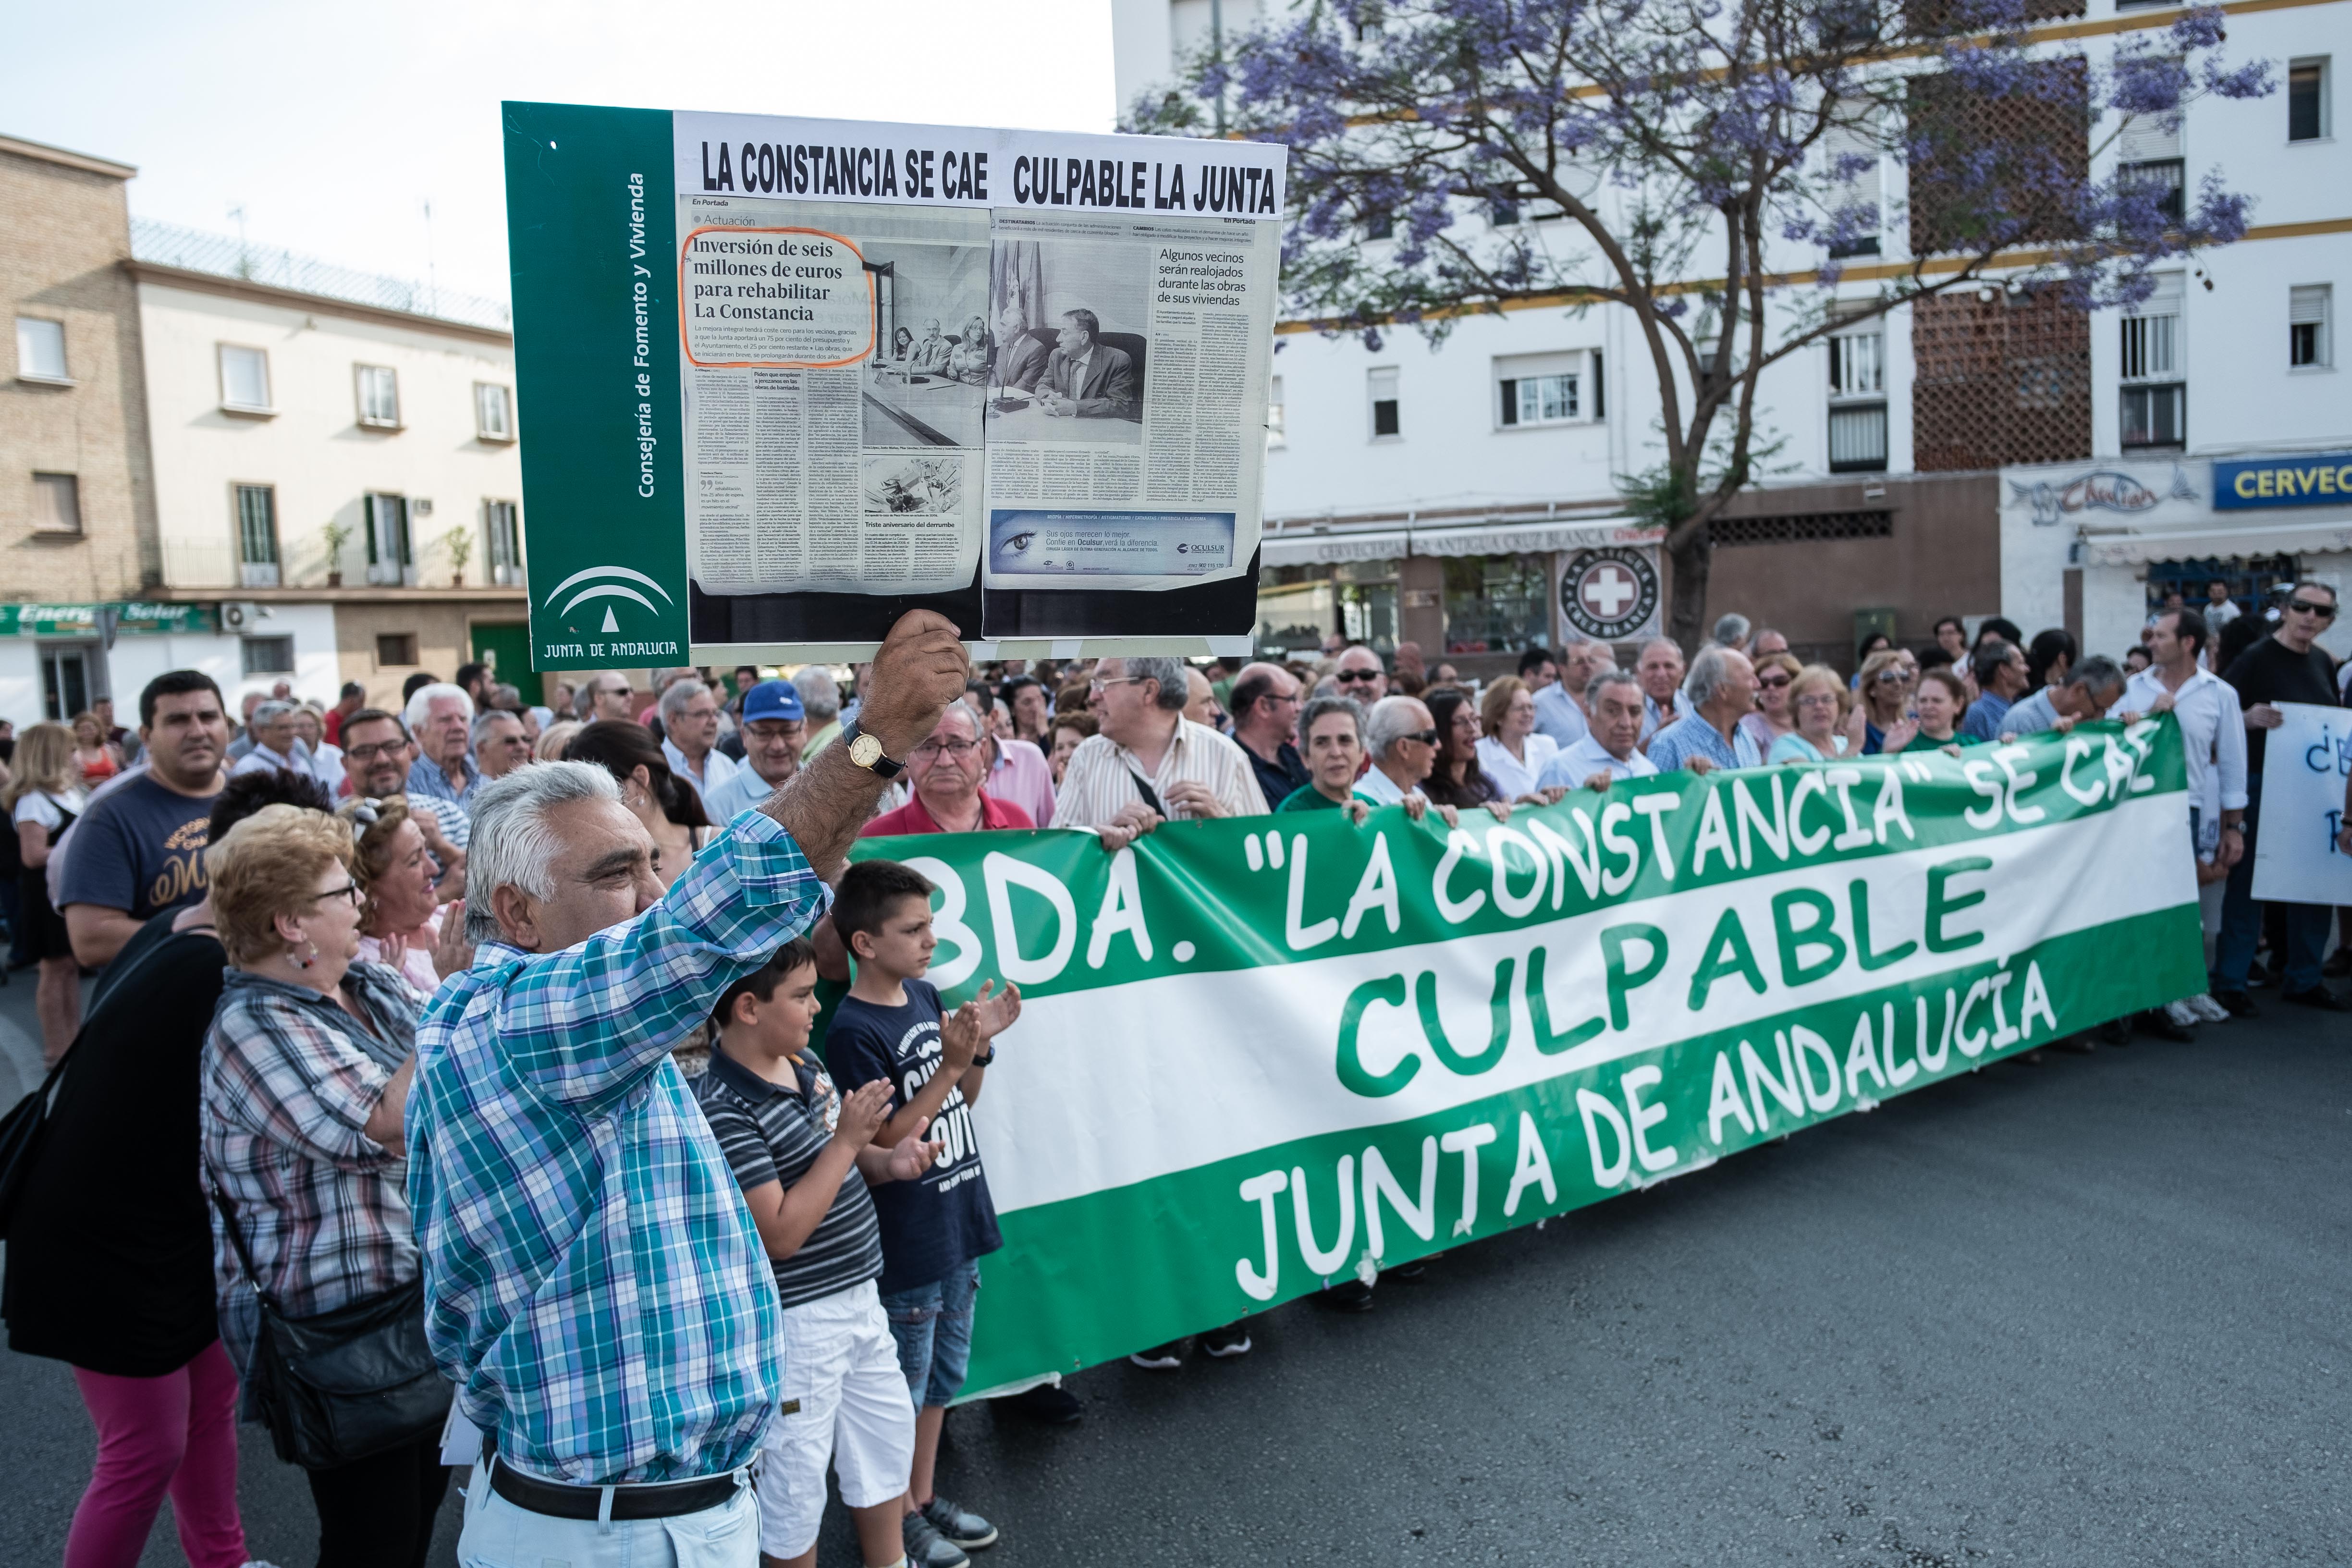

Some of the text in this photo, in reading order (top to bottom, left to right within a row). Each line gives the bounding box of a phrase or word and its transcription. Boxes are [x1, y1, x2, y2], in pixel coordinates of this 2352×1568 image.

[702, 141, 988, 200] LA CONSTANCIA SE CAE
[1013, 155, 1276, 215] CULPABLE LA JUNTA
[703, 215, 756, 226] Actuación
[692, 237, 833, 257] Inversión de seis
[1160, 248, 1243, 263] Algunos vecinos
[694, 259, 842, 279] millones de euros
[1159, 264, 1243, 278] serán realojados
[694, 282, 830, 300] para rehabilitar
[1158, 277, 1245, 292] durante las obras
[1157, 291, 1239, 306] de sus viviendas
[694, 303, 814, 320] La Constancia
[628, 172, 656, 498] Consejería de Fomento y Vivienda
[1045, 529, 1131, 539] Sus ojos merecen lo mejor.
[18, 603, 98, 624] Energ
[124, 602, 190, 621] Solar
[544, 641, 678, 658] JUNTA DE ANDALUCIA
[1244, 830, 1401, 951] "LA
[1433, 762, 1932, 925] CONSTANCIA"
[1964, 748, 2046, 830] SE
[2060, 719, 2163, 807] CAE
[1336, 857, 1993, 1098] CULPABLE
[931, 1102, 977, 1169] OUT
[1235, 952, 2057, 1301] JUNTA DE ANDALUCÍA
